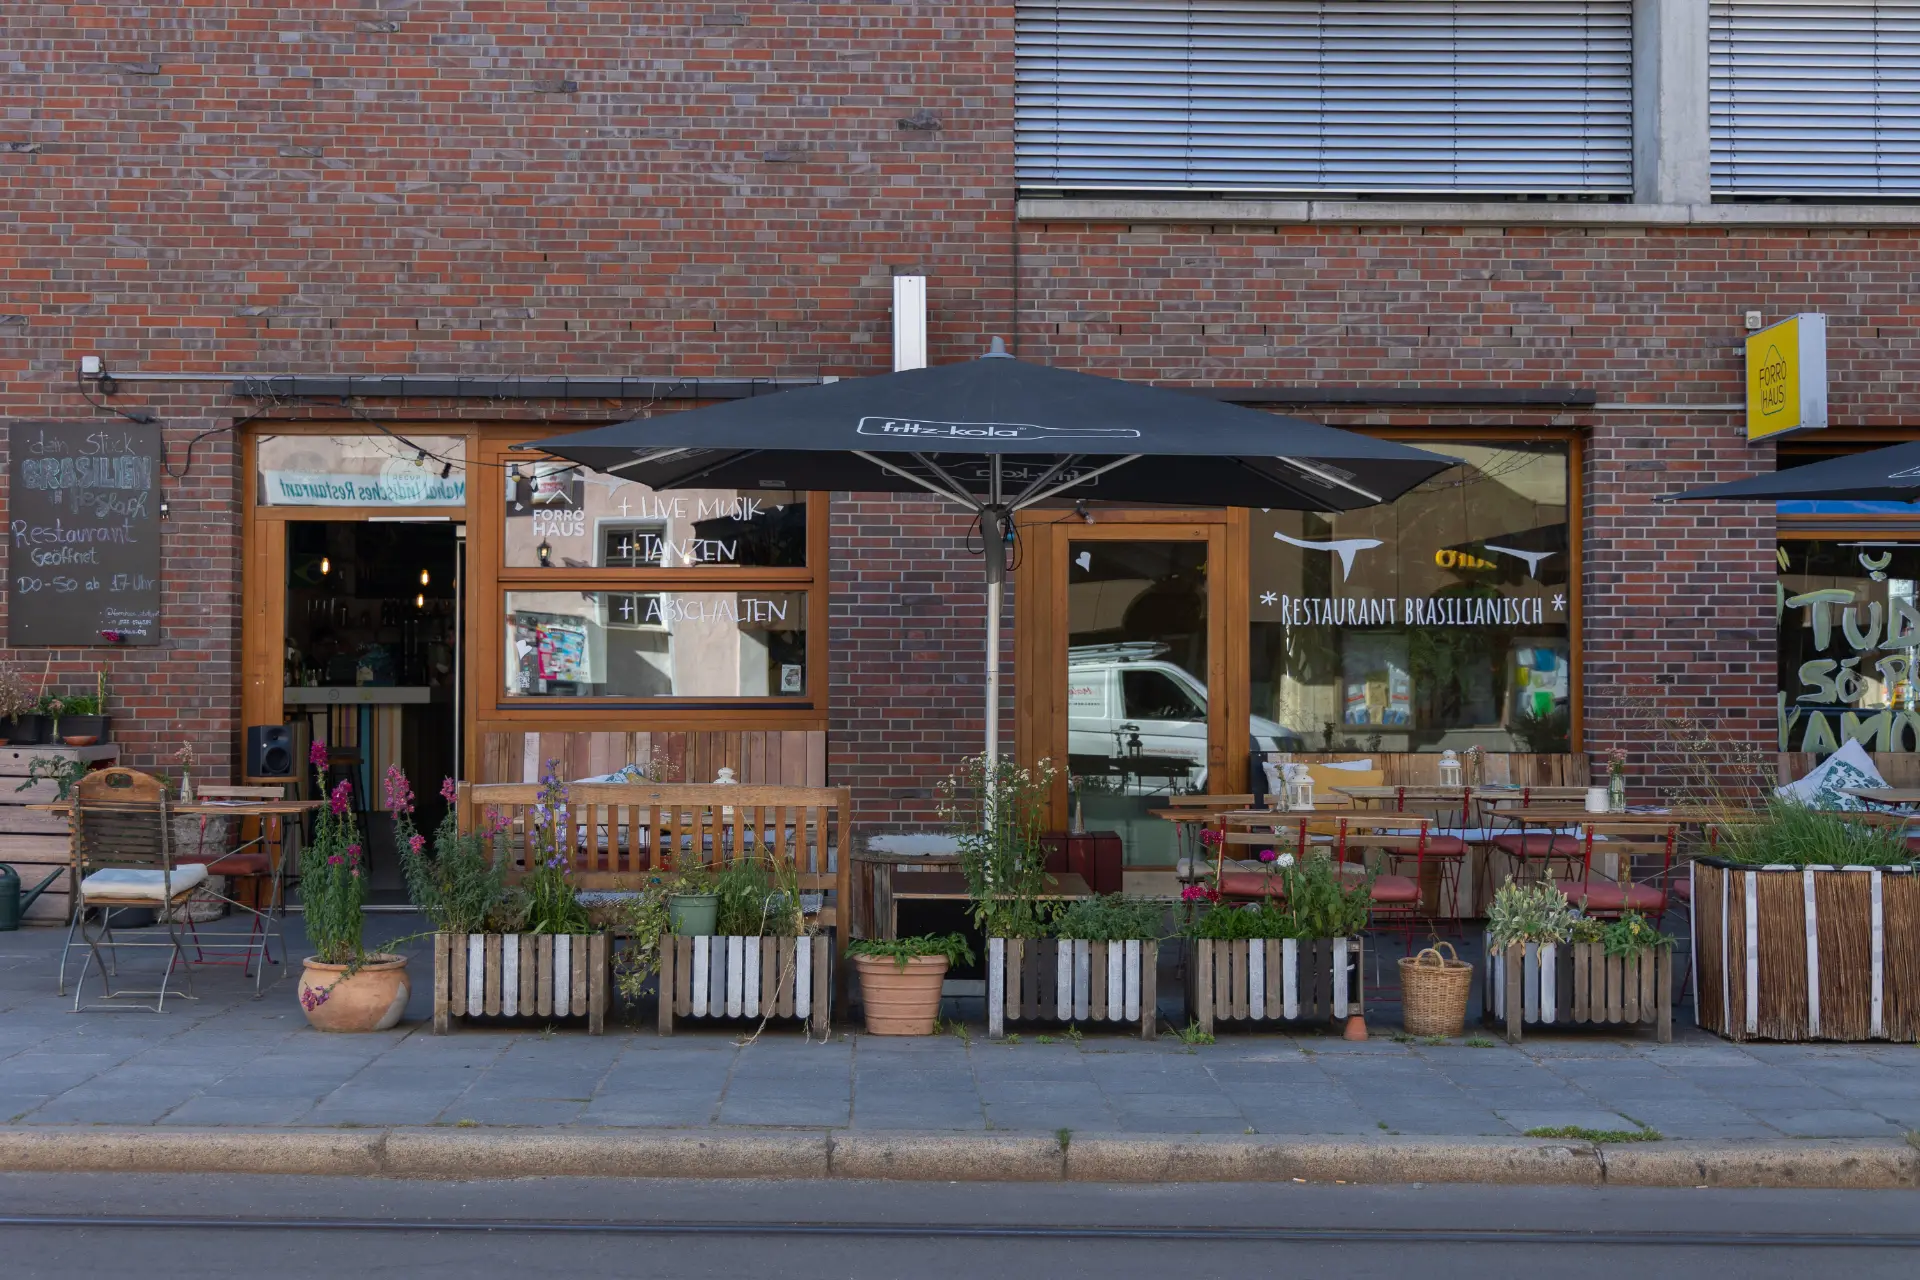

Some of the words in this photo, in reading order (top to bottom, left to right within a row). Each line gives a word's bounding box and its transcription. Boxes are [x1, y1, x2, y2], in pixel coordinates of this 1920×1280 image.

[1759, 356, 1787, 388] FORRÓ
[1762, 385, 1785, 408] HAUS
[881, 422, 1018, 437] fritz-kola
[21, 455, 152, 490] BRASILIEN
[533, 506, 585, 522] FORRÓ
[642, 496, 688, 519] LIVE
[698, 497, 766, 521] MUSIK
[12, 518, 138, 549] Restaurant
[533, 522, 585, 537] HAUS
[639, 533, 737, 562] TANZEN
[85, 576, 100, 591] ab
[646, 598, 787, 622] ABSCHALTEN
[1282, 594, 1396, 626] RESTAURANT
[1405, 596, 1543, 626] BRASILIANISCH
[1796, 656, 1869, 704] SÓ
